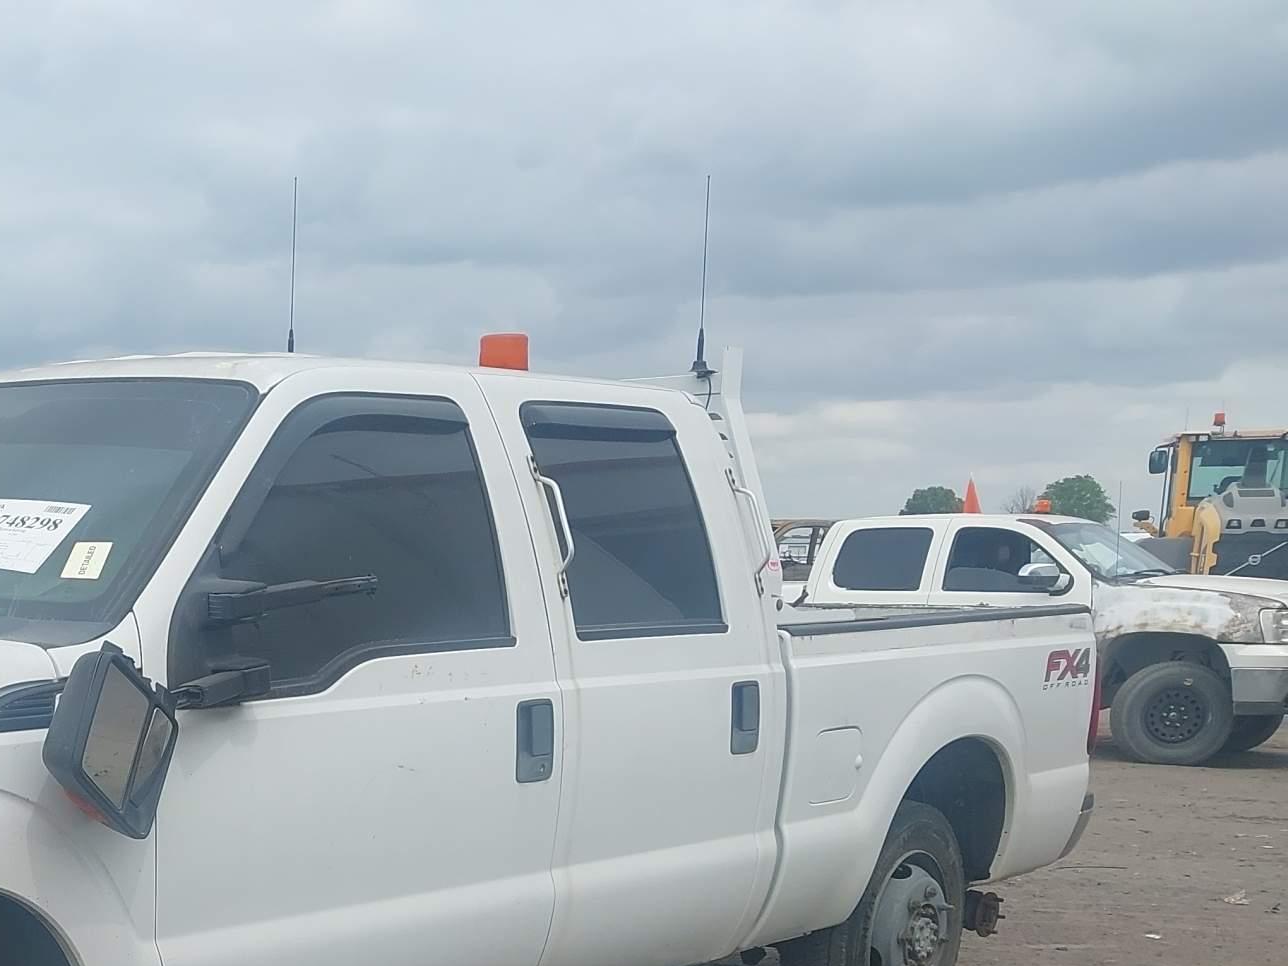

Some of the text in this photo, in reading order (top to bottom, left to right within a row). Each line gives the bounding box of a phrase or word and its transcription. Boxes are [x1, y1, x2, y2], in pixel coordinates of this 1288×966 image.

[78, 545, 96, 575] DETAILED
[1044, 647, 1091, 682] FX4
[1042, 679, 1089, 691] OFF ROAD
